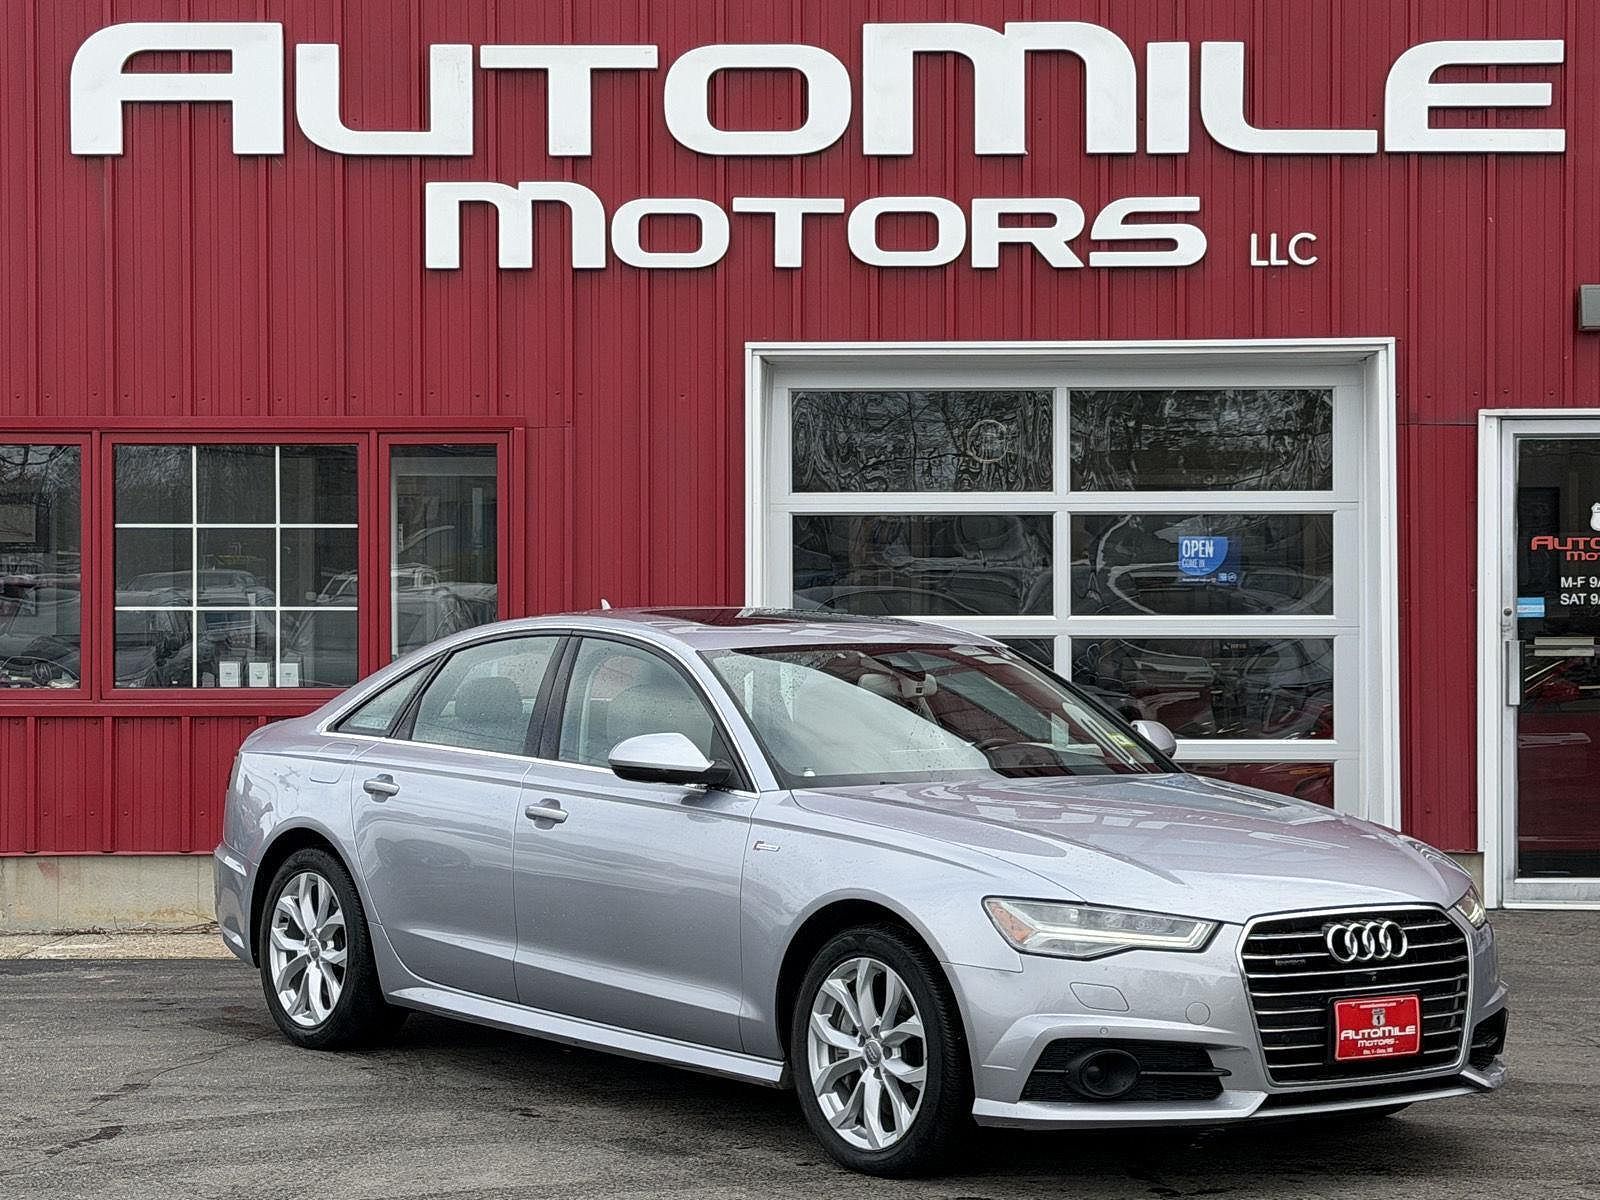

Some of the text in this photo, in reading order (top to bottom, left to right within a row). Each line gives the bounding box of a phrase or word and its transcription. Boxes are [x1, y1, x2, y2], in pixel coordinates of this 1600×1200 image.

[70, 21, 1566, 155] AUTOMILE
[425, 181, 1319, 269] MOTORS LLC
[1182, 539, 1214, 558] OPEN
[1560, 576, 1586, 588] M-F
[1560, 593, 1600, 605] SAT 9
[1340, 1025, 1416, 1041] AUTOMILE
[1357, 1038, 1395, 1048] MOTORS
